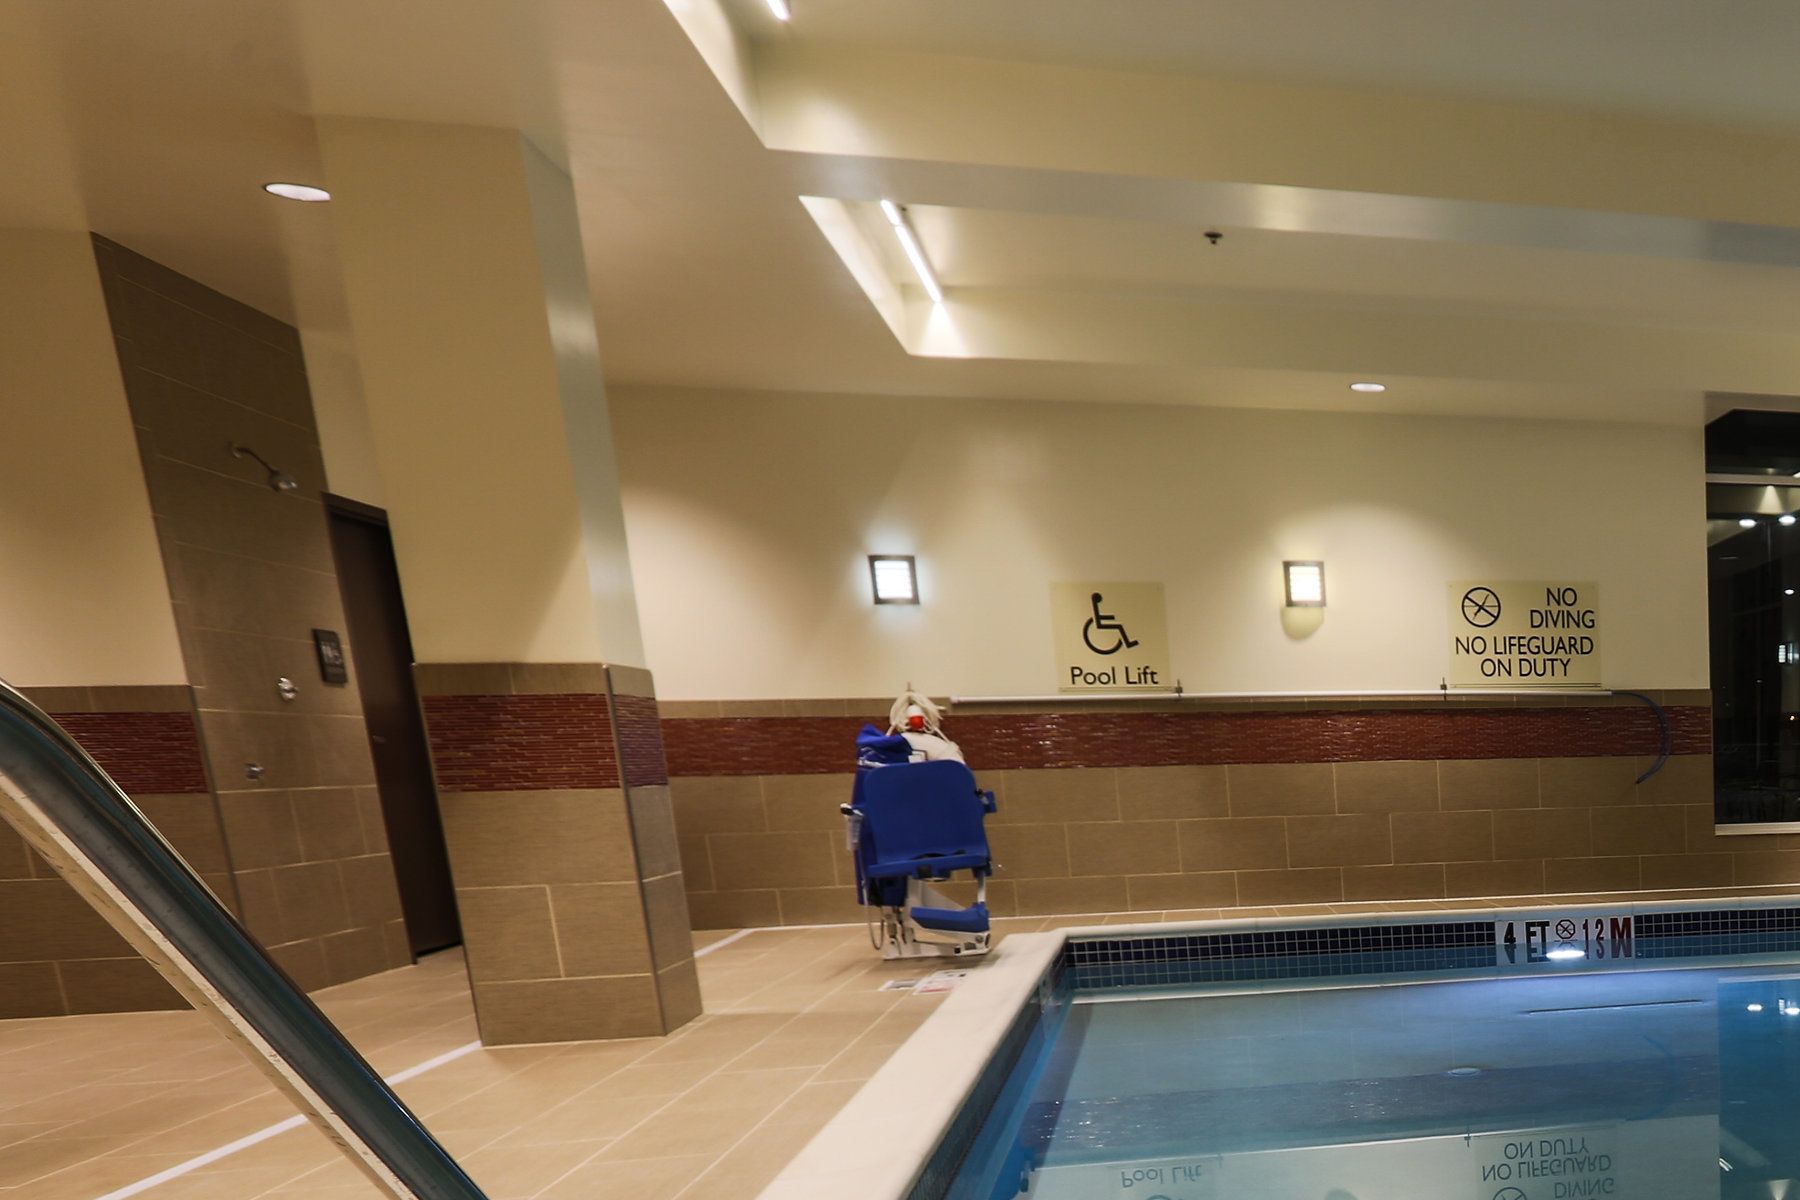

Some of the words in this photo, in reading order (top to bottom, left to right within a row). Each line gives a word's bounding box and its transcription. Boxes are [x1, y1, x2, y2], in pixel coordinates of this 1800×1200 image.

[1546, 587, 1578, 607] NO
[1530, 609, 1596, 629] DIVING
[1455, 636, 1487, 655] NO
[1493, 635, 1594, 655] LIFEGUARD
[1070, 666, 1116, 685] Pool
[1125, 665, 1159, 685] Lift
[1480, 658, 1512, 677] ON
[1519, 657, 1571, 677] DUTY
[1504, 922, 1516, 943] 4
[1525, 921, 1550, 944] FT
[1609, 917, 1632, 941] M
